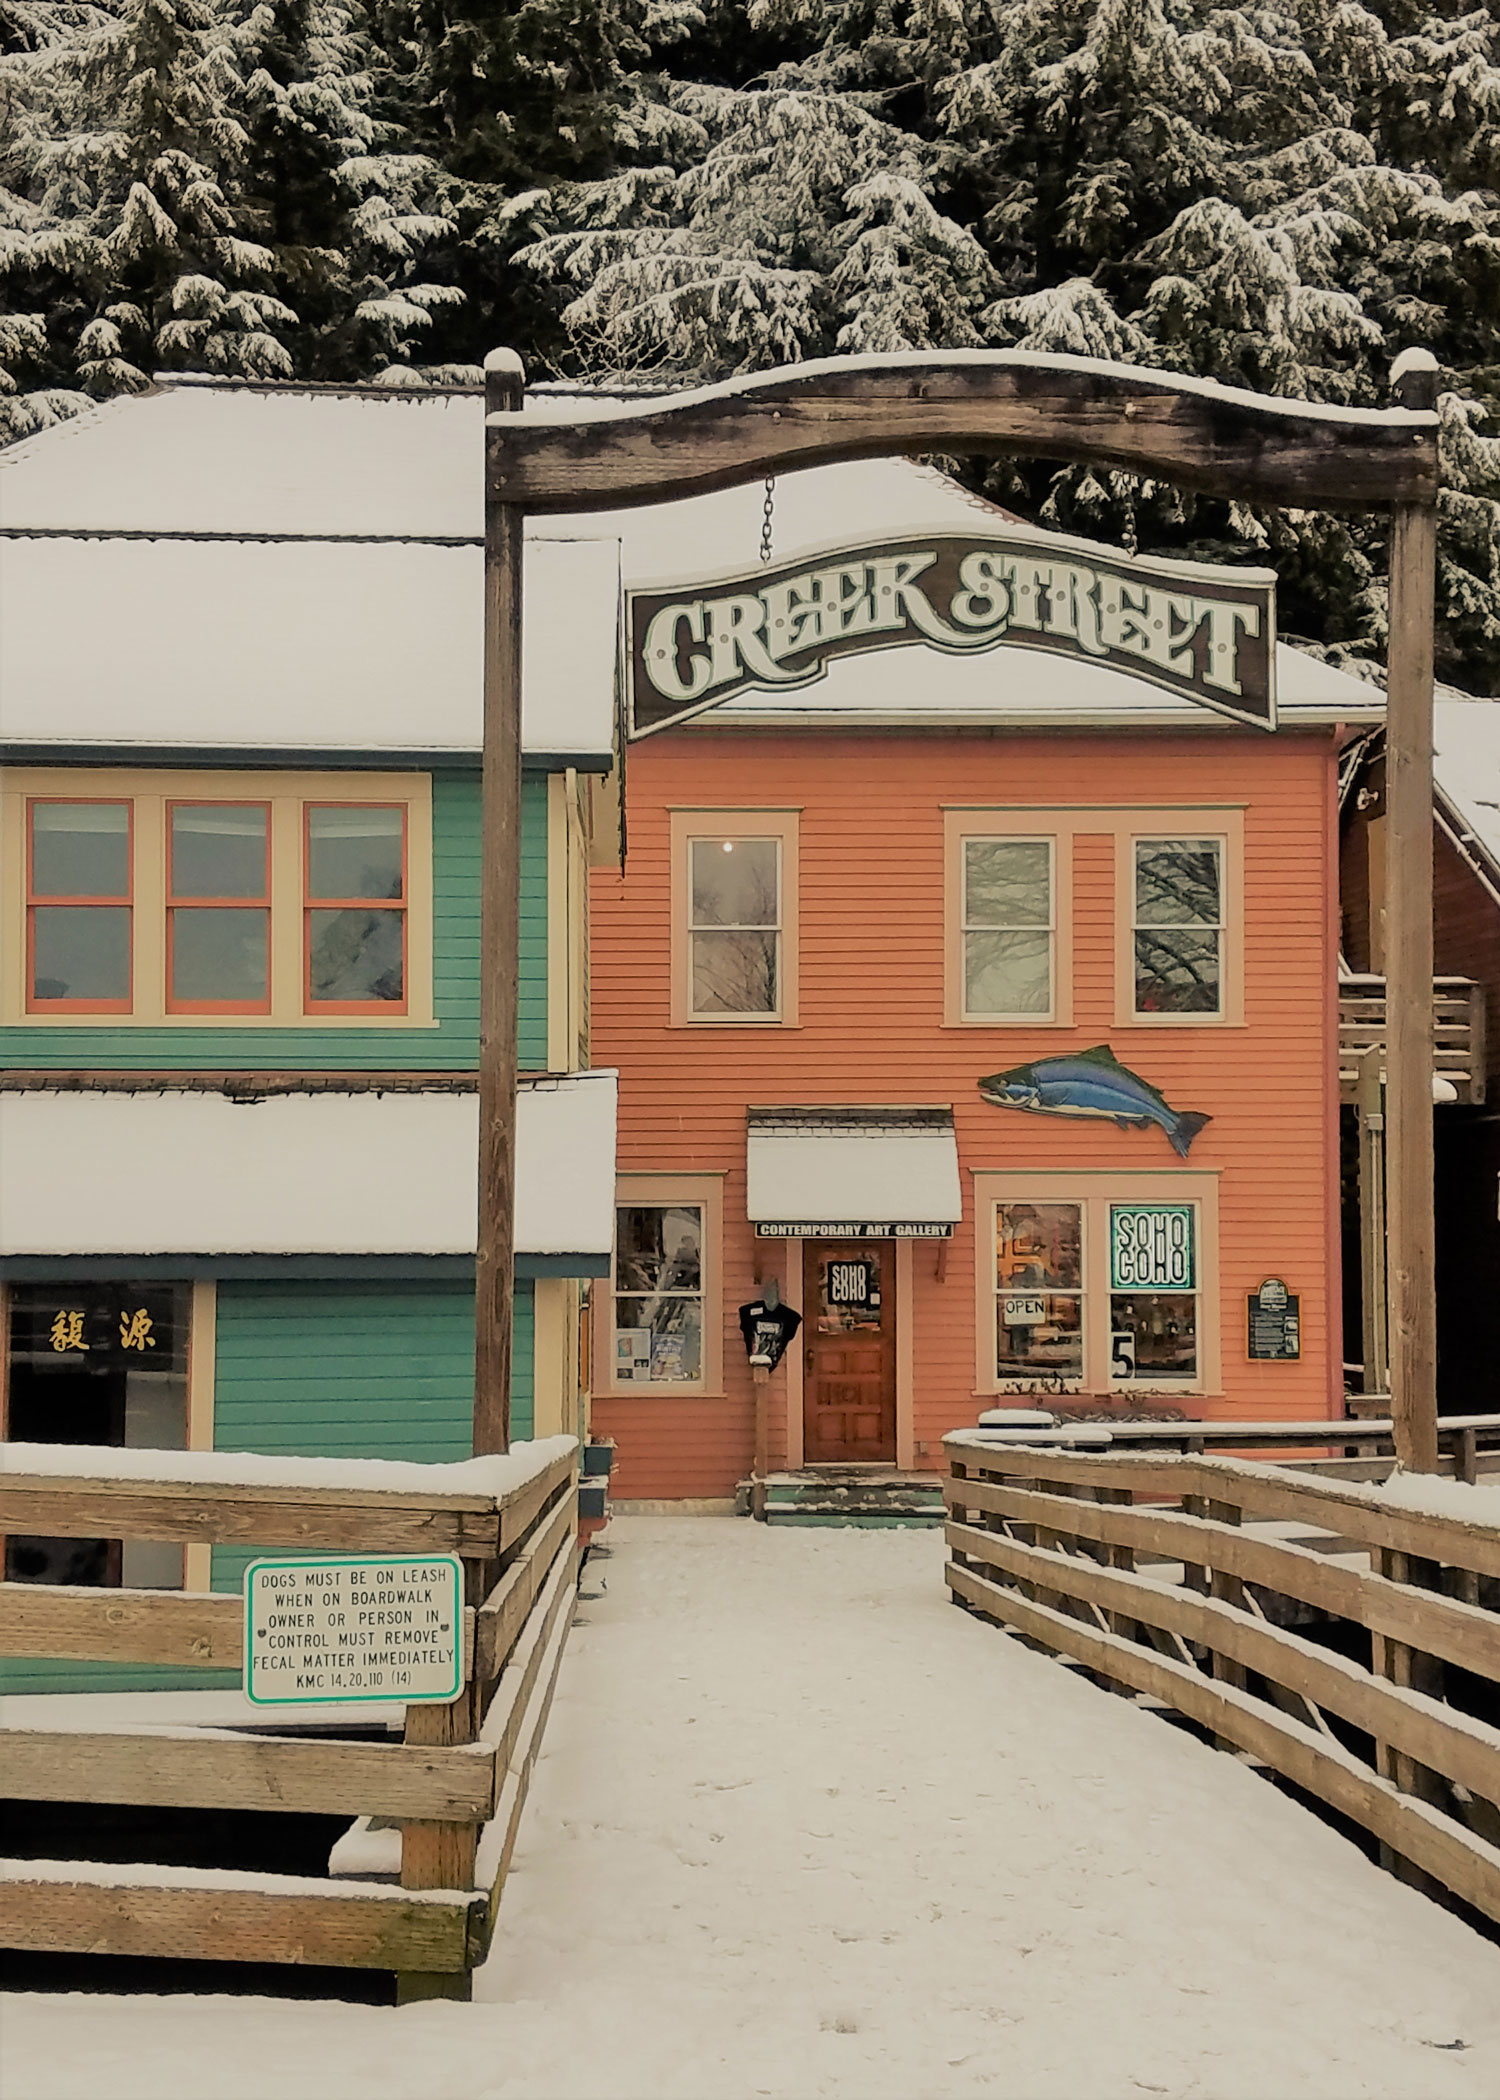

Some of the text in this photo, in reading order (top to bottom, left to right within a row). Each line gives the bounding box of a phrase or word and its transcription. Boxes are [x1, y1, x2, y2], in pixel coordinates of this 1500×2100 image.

[643, 550, 1260, 701] CREEK STREET
[760, 1224, 948, 1236] CONTEMPORARY ART GALLERY
[1117, 1212, 1188, 1246] SOHO
[832, 1265, 867, 1282] SOHO
[1117, 1248, 1188, 1285] COHO
[832, 1282, 867, 1301] COHO
[1005, 1299, 1046, 1314] OPEN
[261, 1569, 446, 1588] DOGS MUST BE ON LEASH
[275, 1589, 432, 1607] WHEN ON BOARDWALK
[268, 1610, 439, 1628] OWNER OR PERSON IN
[268, 1630, 438, 1649] CONTROL MUST REMOVE
[253, 1649, 454, 1670] FECAL MATTER IMMEDIATELY
[296, 1670, 411, 1688] KMC 14.20.110 (14)
